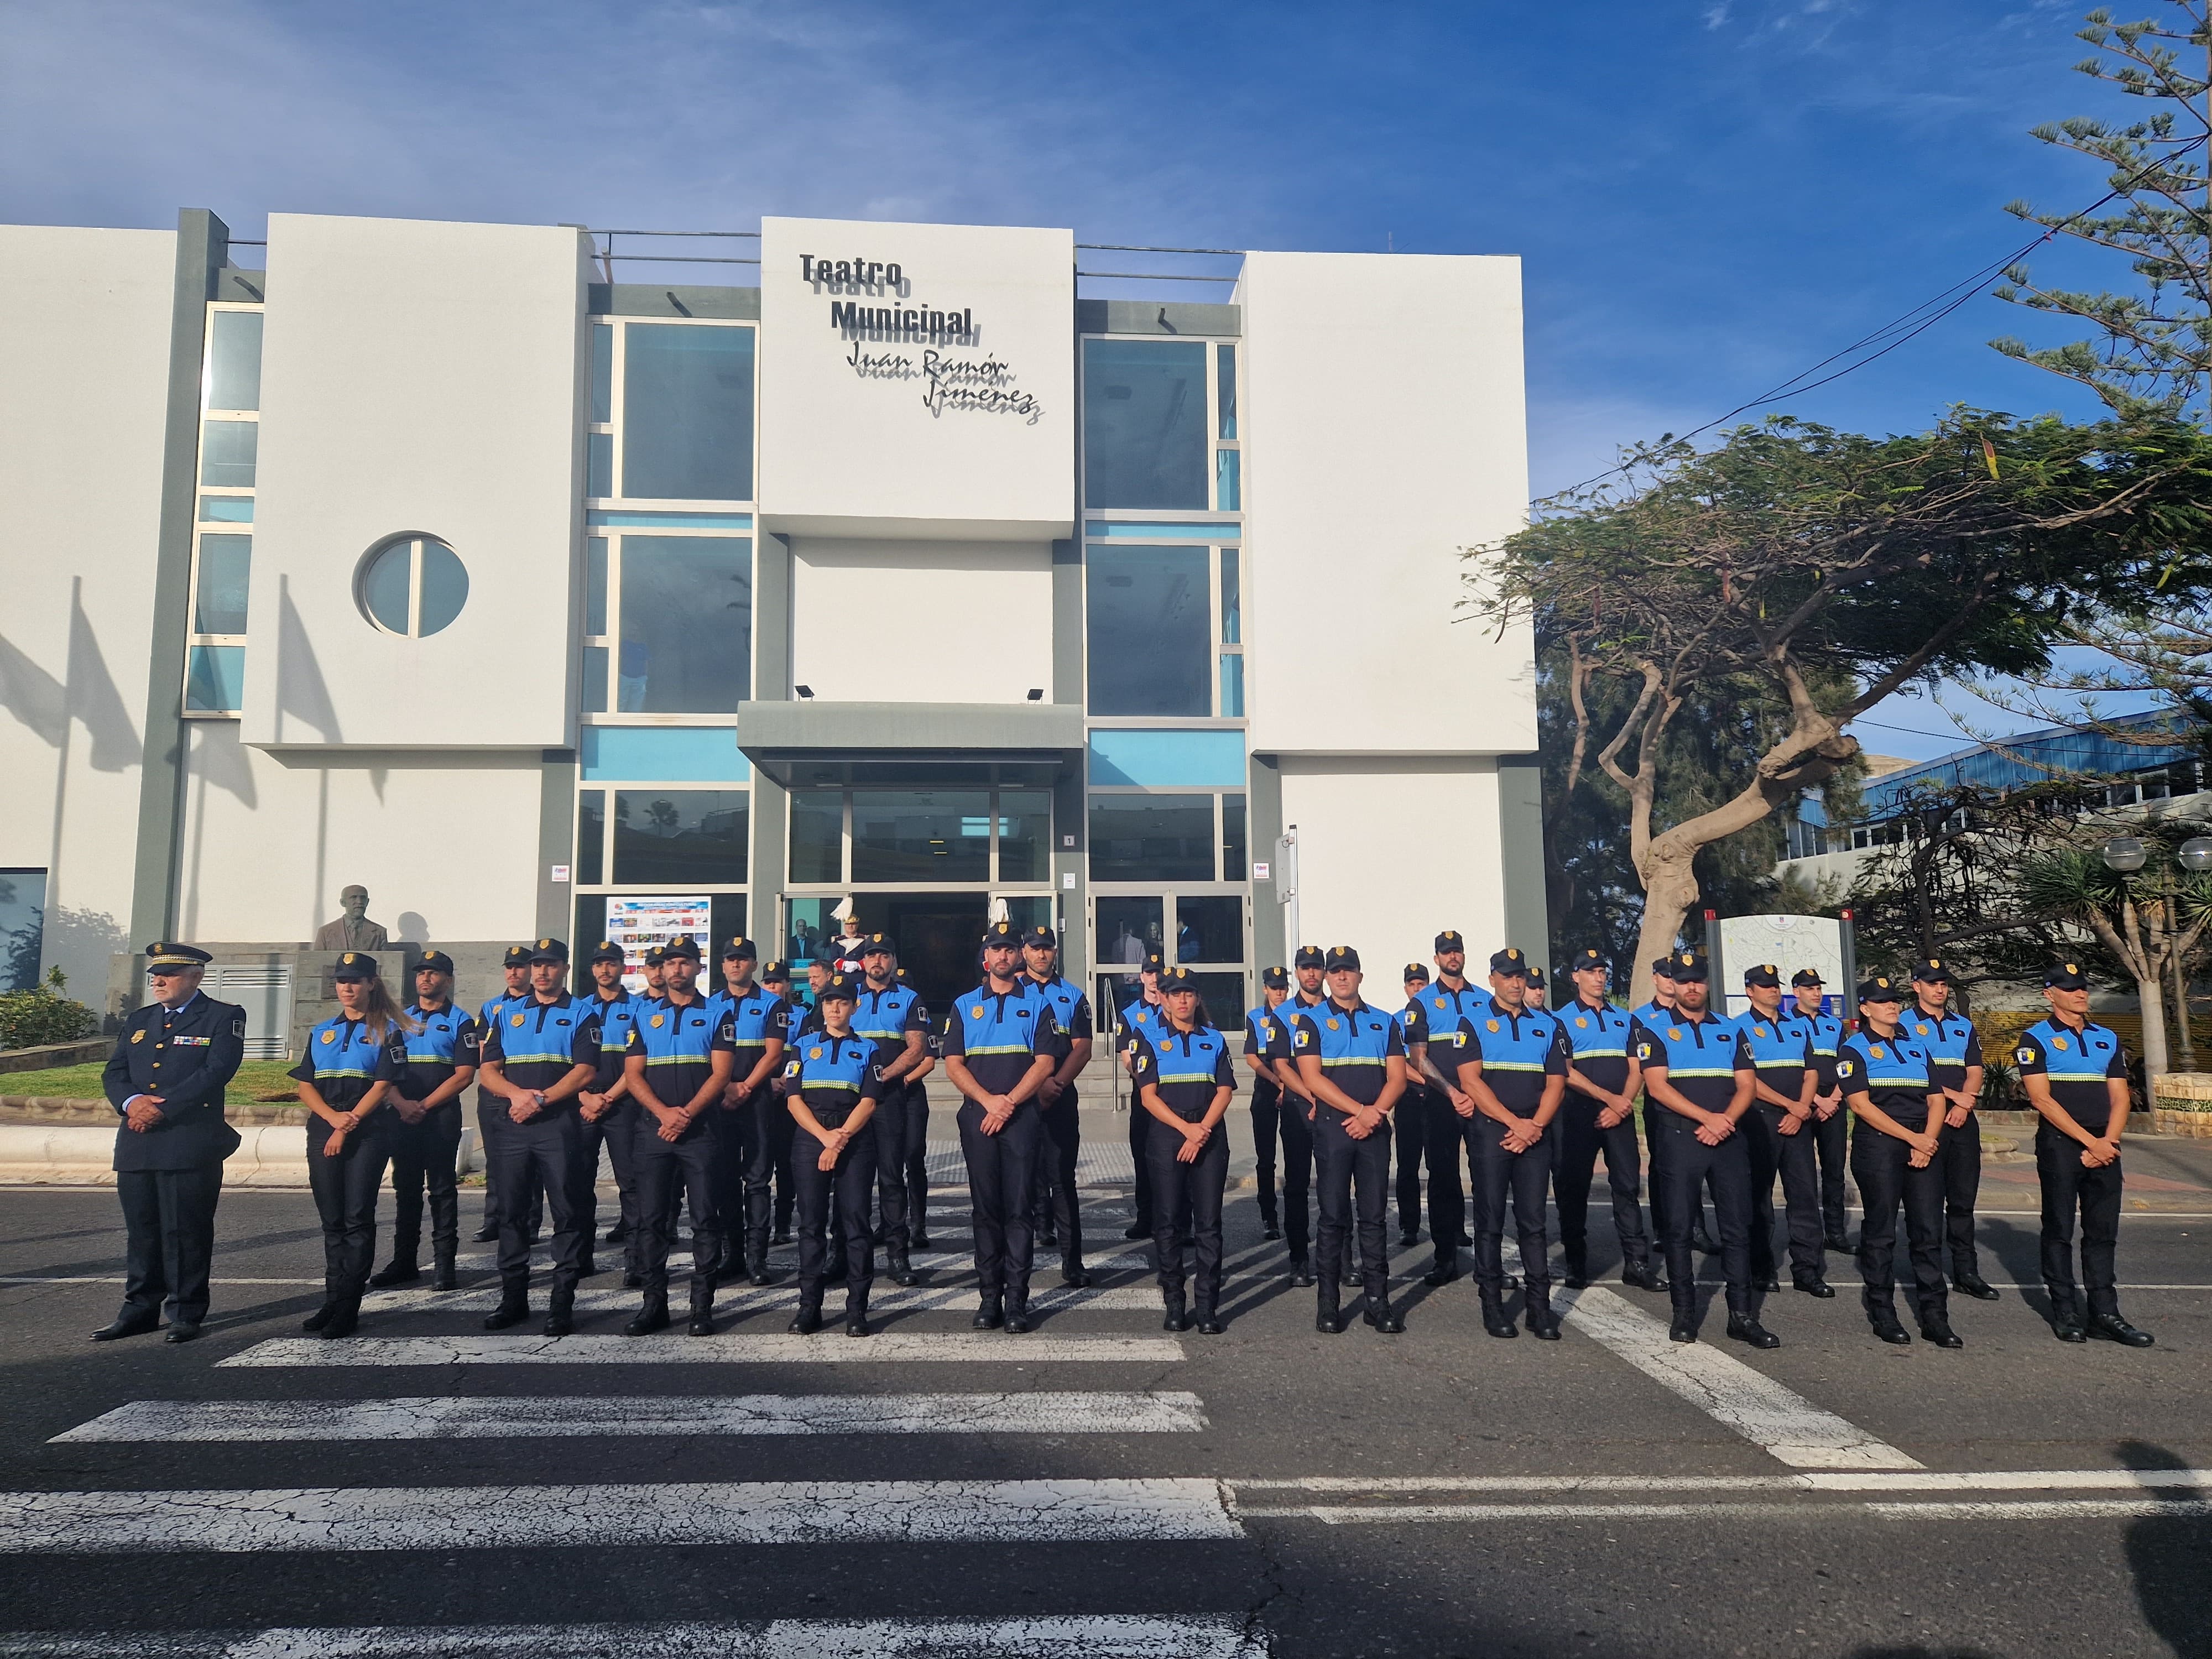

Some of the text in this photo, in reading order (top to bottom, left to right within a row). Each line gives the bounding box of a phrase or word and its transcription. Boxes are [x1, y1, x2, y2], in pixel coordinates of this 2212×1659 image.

[799, 254, 901, 285] Teatro
[831, 301, 971, 337] Municipal
[846, 340, 1009, 379] Juan Ramón
